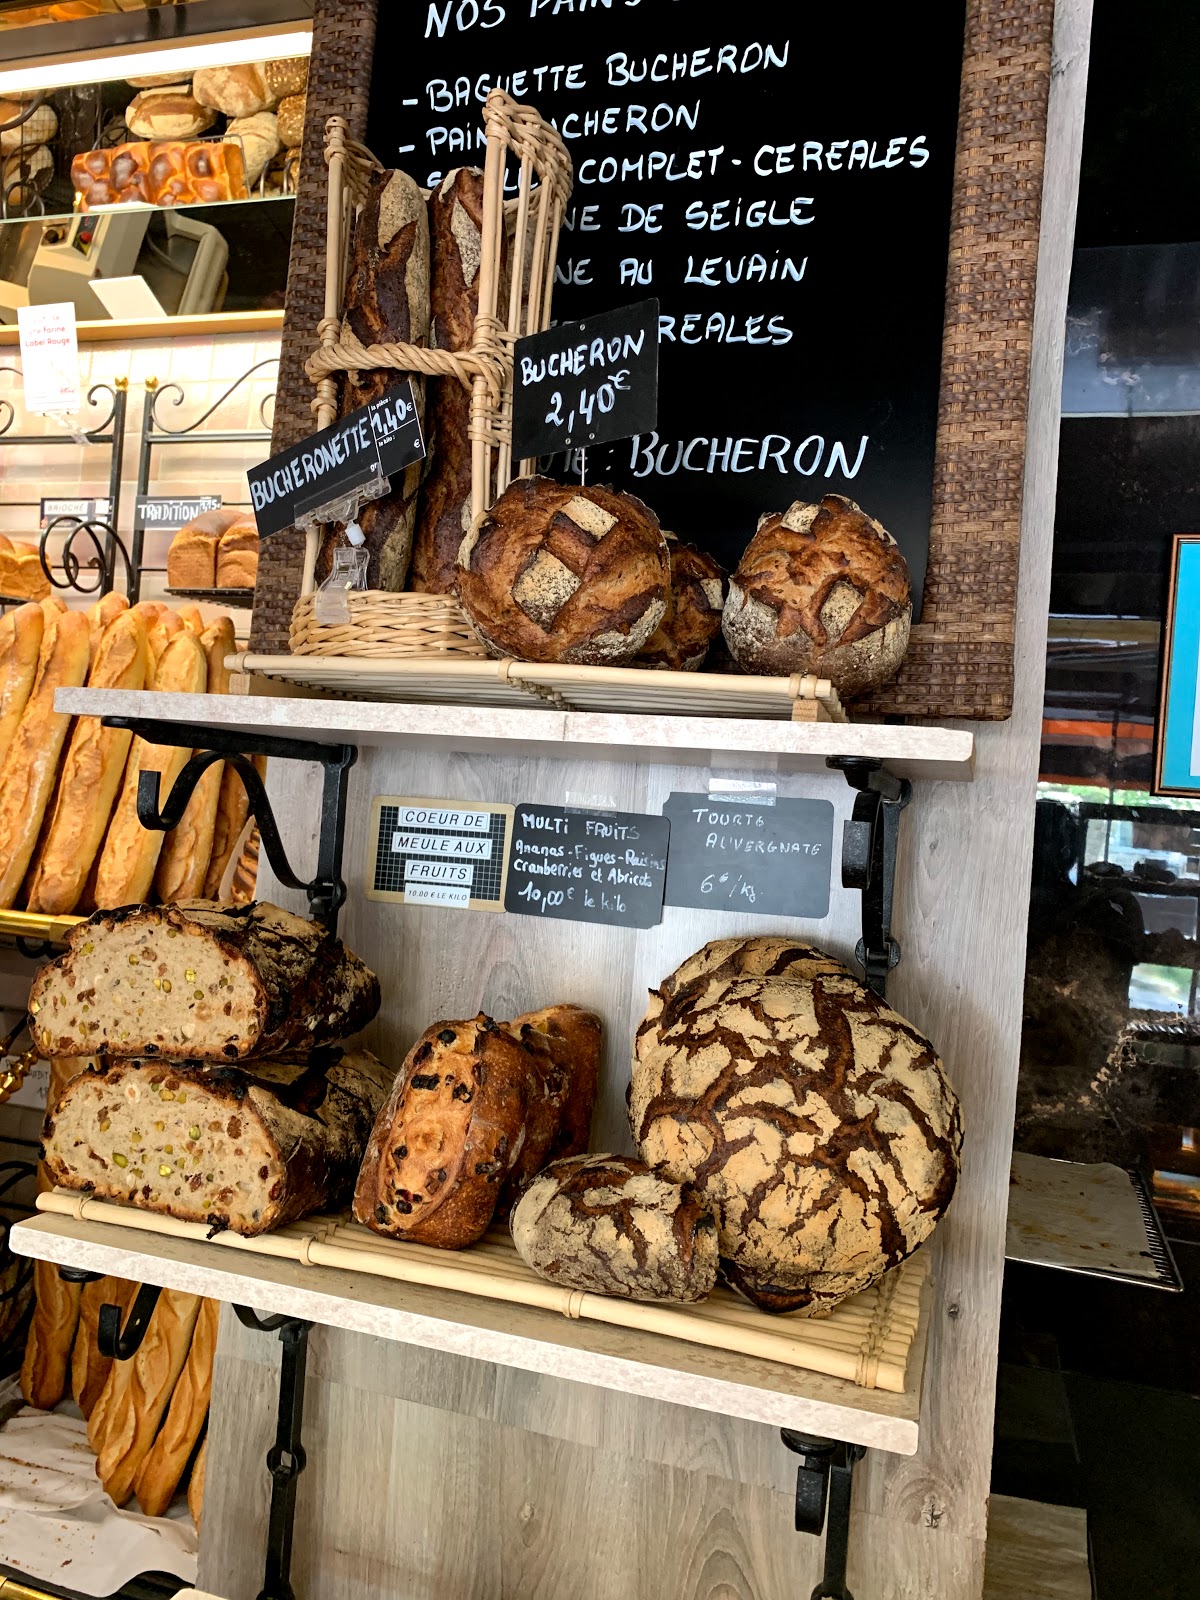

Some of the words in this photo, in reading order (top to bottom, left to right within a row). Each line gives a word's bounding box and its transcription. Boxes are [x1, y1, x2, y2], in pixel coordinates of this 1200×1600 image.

[424, 0, 506, 38] NOS
[605, 40, 790, 87] BUCHERON
[578, 145, 725, 184] COMPLET
[753, 135, 930, 177] CEREALES
[617, 203, 664, 233] DE
[618, 258, 653, 286] AU
[520, 329, 646, 386] BUCHERON
[250, 416, 372, 512] BUCHERONETTE
[629, 430, 870, 480] BUCHERON
[405, 810, 460, 826] COEUR
[463, 814, 485, 827] DE
[397, 836, 450, 852] MEULE
[453, 841, 486, 855] AUX
[409, 864, 468, 880] FRUITS
[590, 871, 603, 883] et
[437, 892, 446, 900] LE
[448, 893, 468, 901] KILO
[584, 889, 596, 908] le
[601, 892, 627, 913] kilo
